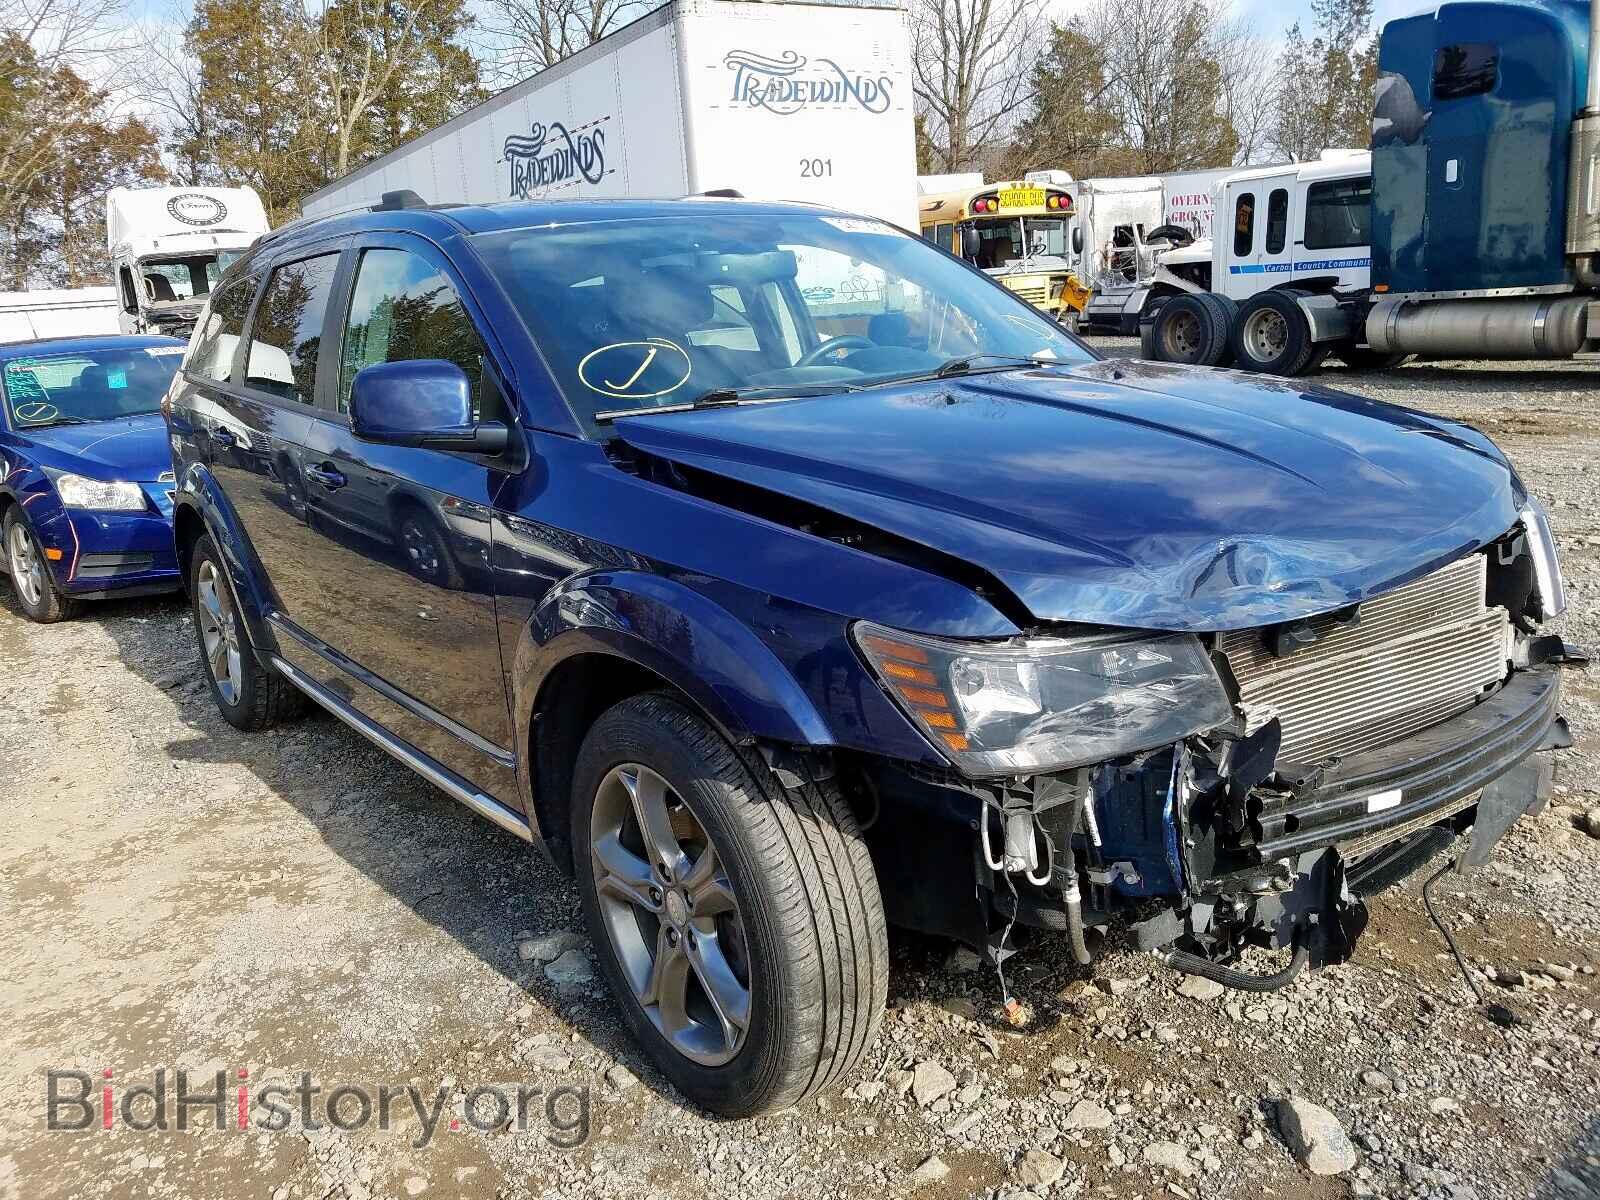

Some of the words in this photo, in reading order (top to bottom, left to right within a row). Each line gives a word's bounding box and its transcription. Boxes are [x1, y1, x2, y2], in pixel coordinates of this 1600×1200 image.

[723, 50, 894, 115] TRADEWINDS
[504, 122, 605, 200] TRADEWINDS
[799, 158, 832, 178] 201
[999, 192, 1028, 207] SCHOOL
[1030, 191, 1045, 206] BUS
[1297, 261, 1327, 270] County
